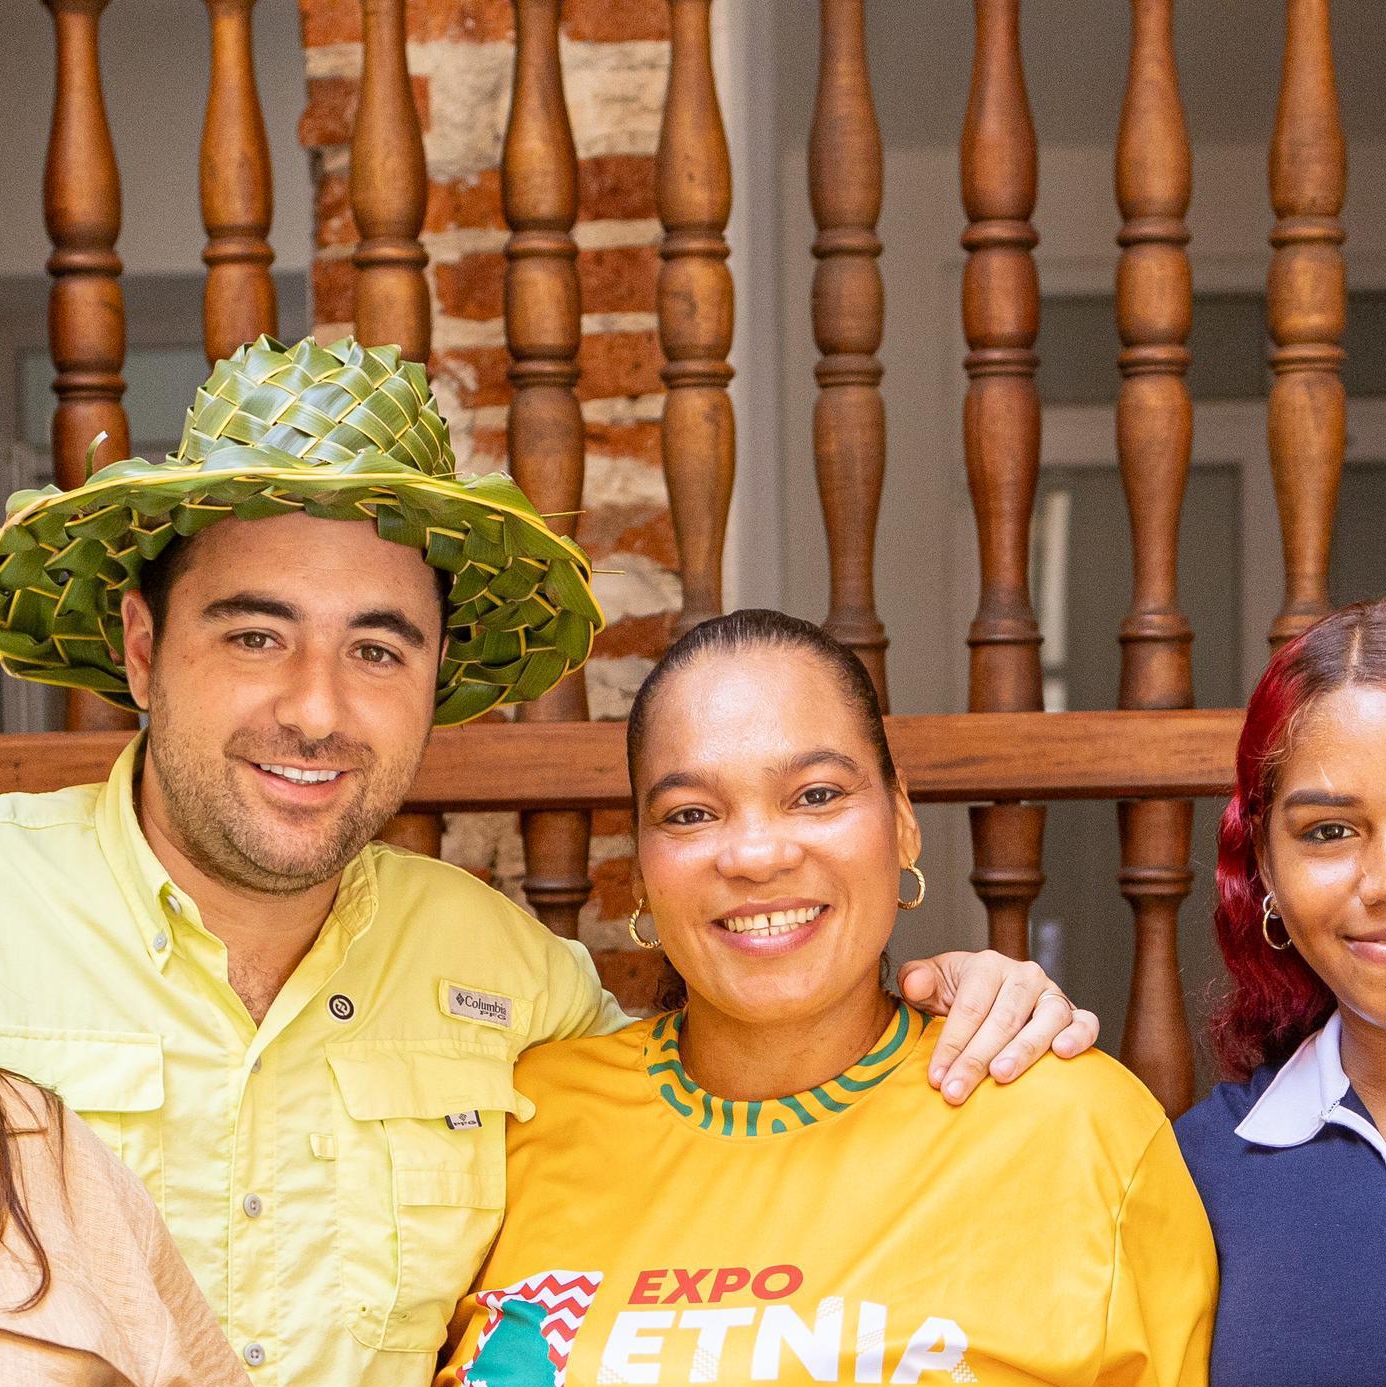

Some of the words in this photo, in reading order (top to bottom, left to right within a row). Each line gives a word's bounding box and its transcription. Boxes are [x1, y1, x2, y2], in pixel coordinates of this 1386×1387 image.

[465, 995, 507, 1015] Columbia
[628, 1264, 804, 1305] EXPO
[596, 1296, 979, 1385] ETNIA
